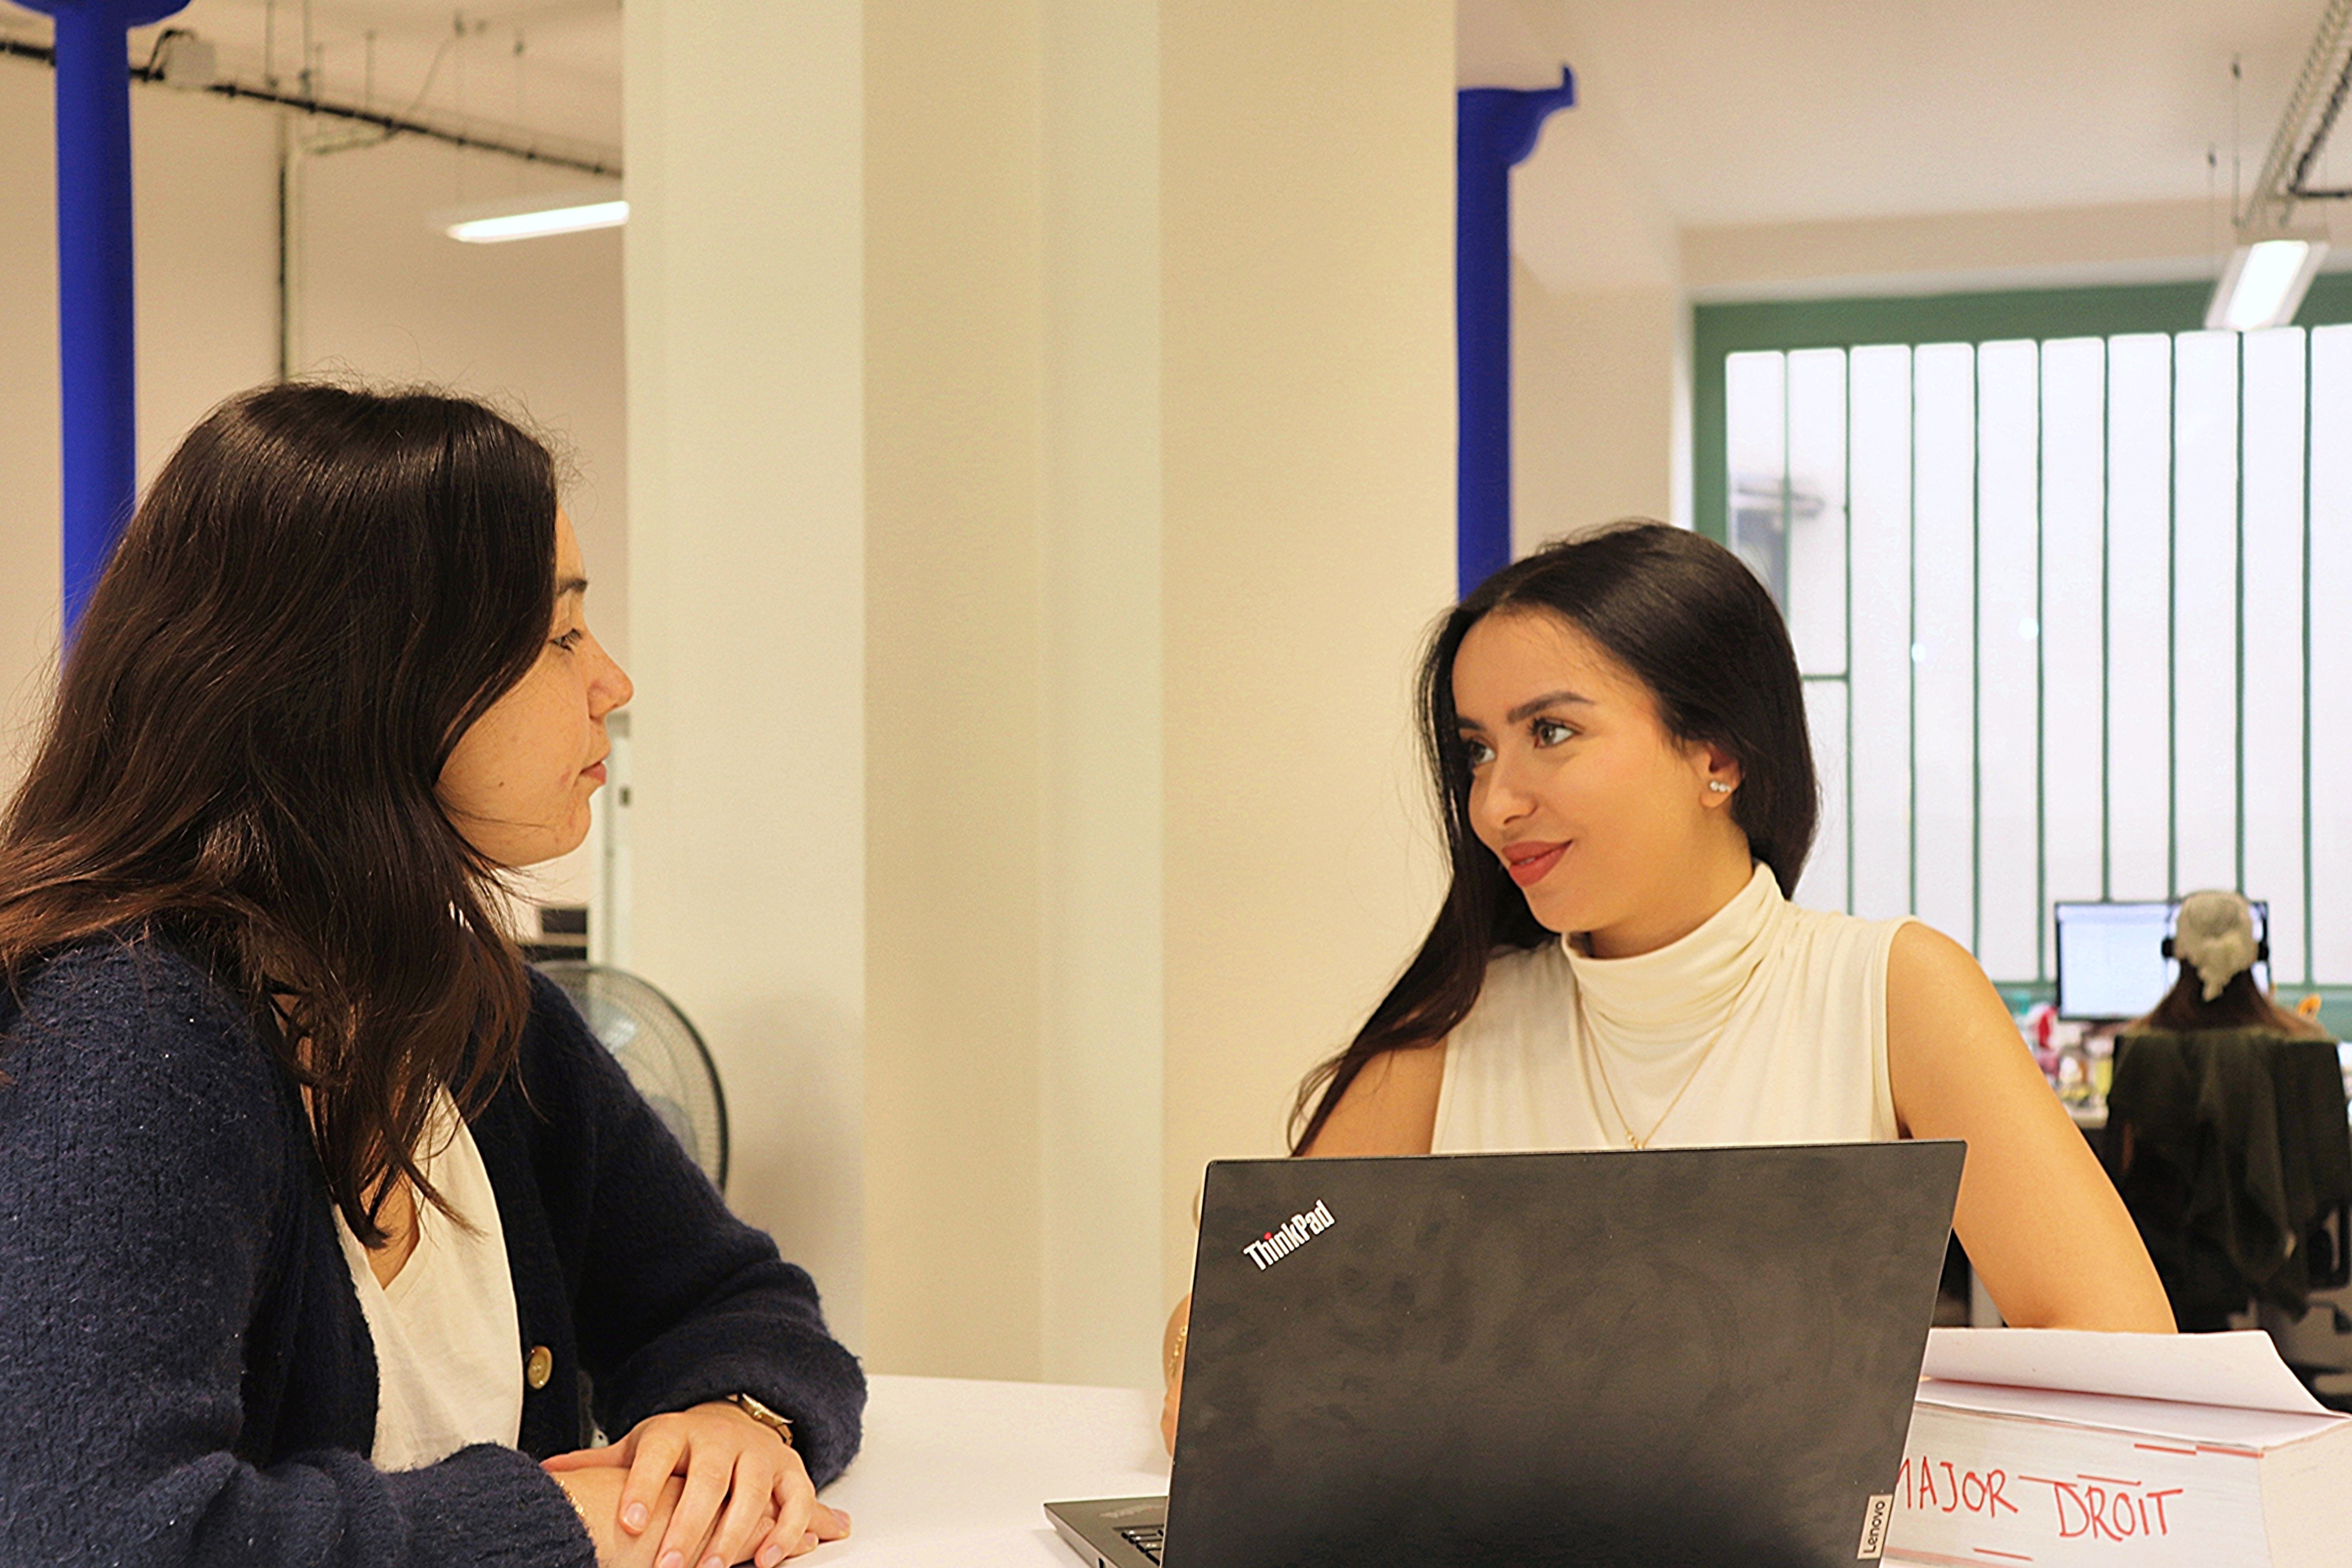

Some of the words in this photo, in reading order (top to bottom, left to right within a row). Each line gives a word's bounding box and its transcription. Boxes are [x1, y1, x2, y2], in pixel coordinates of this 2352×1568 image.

[1243, 1199, 1335, 1271] ThinkPad
[1863, 1500, 1886, 1553] Lenovo
[2054, 1482, 2183, 1542] DROIT
